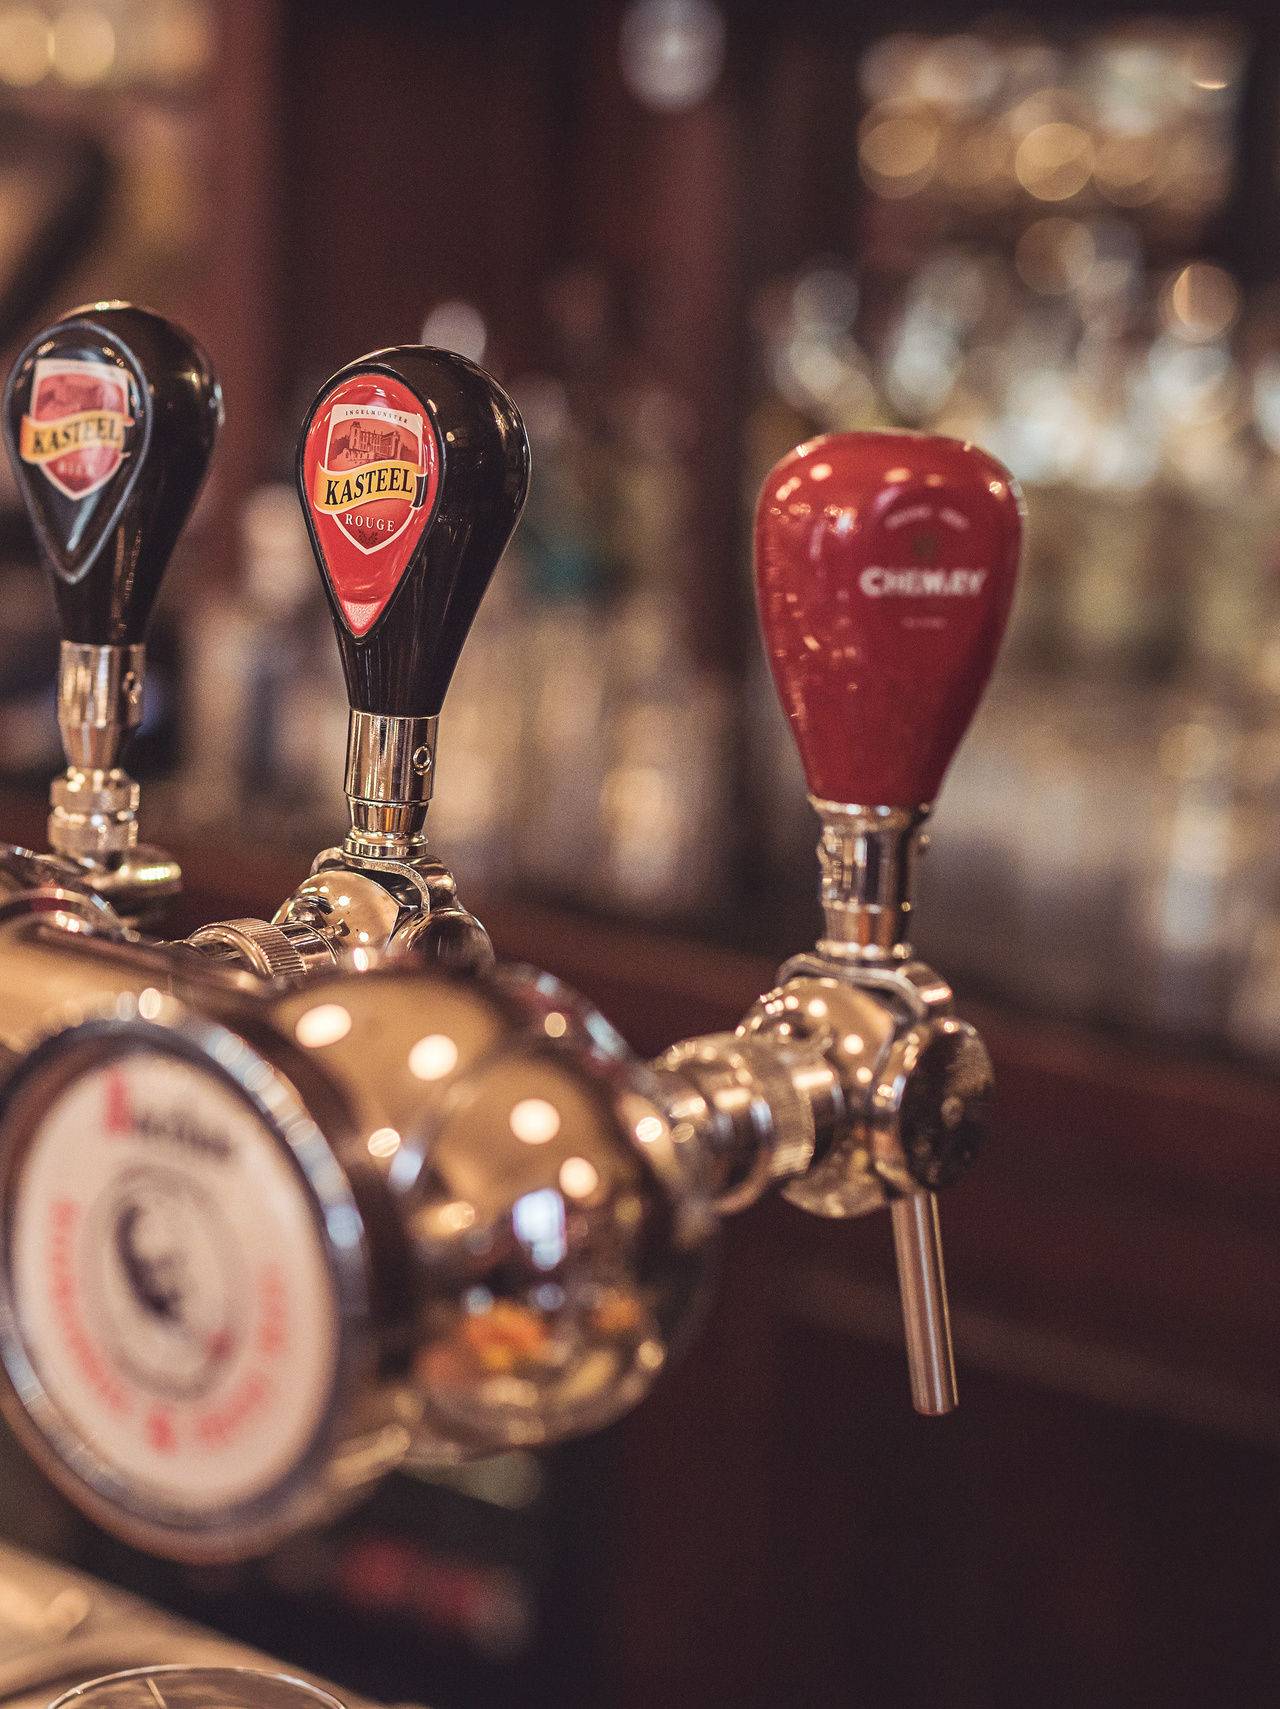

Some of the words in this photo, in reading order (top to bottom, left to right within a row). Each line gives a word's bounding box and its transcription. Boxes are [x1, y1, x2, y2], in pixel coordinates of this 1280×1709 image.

[345, 410, 408, 424] INGELMUNSTER
[33, 418, 119, 455] KASTEEL
[324, 467, 414, 506] KASTEEL
[345, 513, 395, 532] ROUGE
